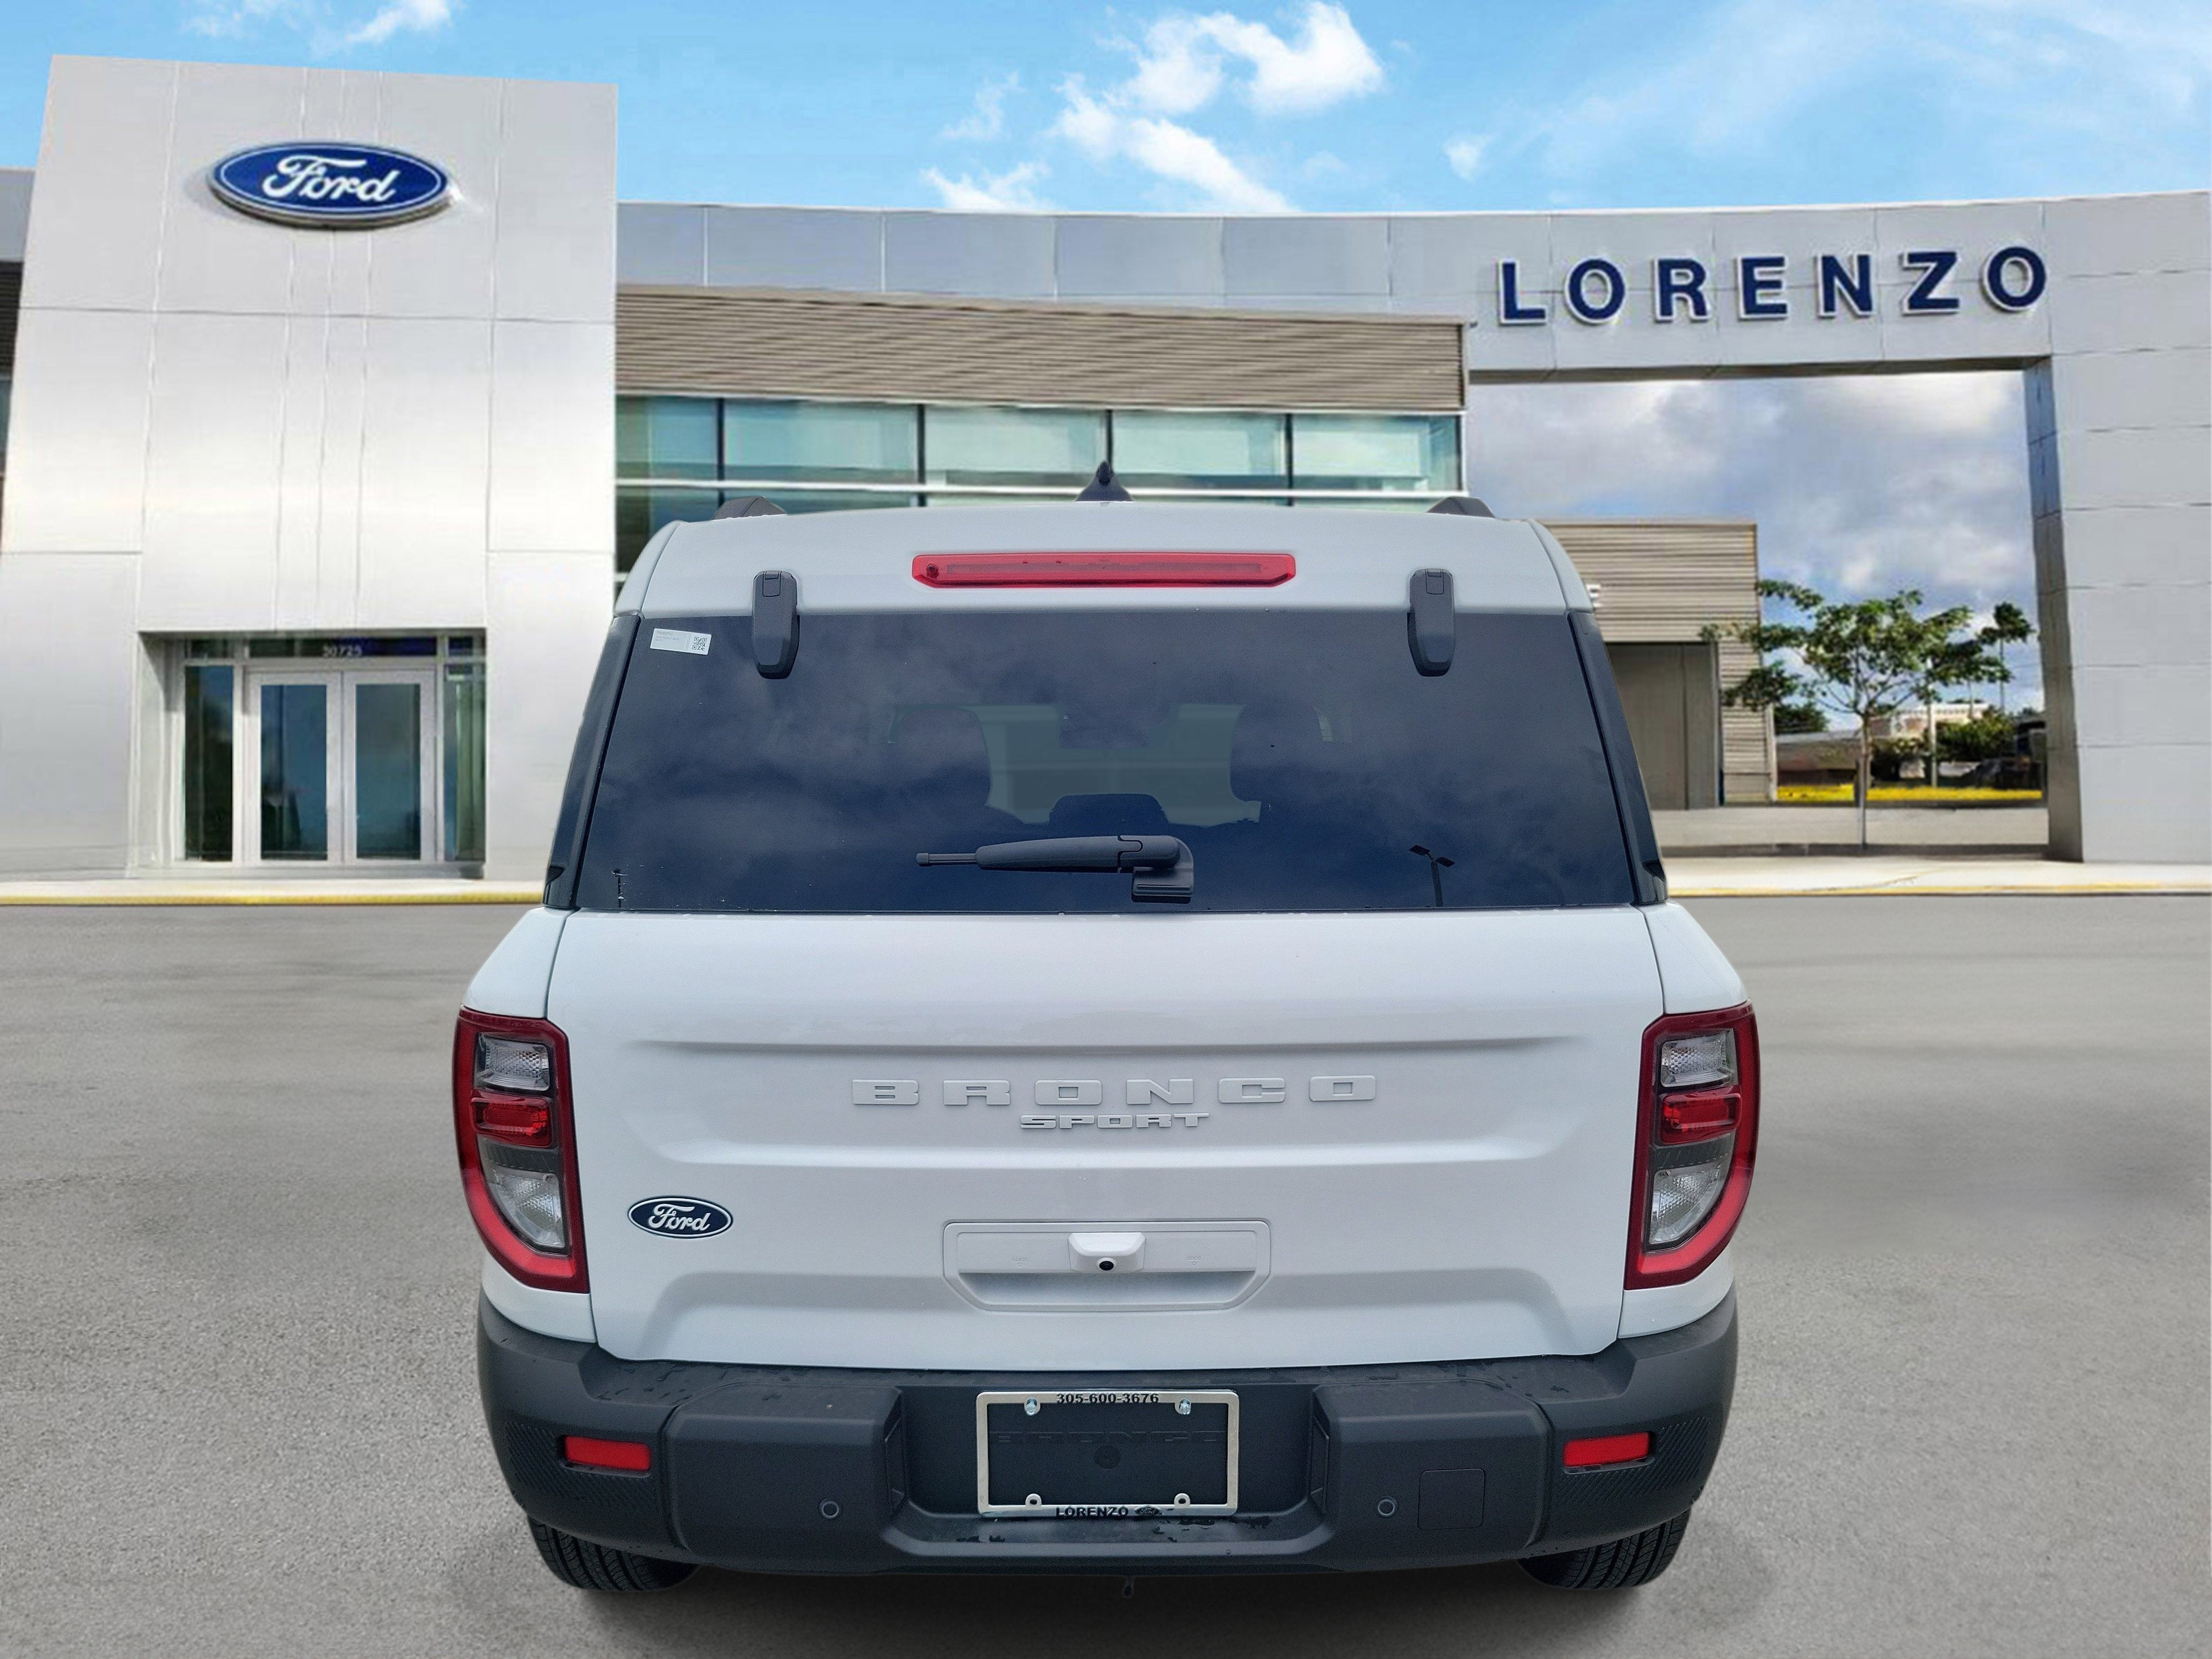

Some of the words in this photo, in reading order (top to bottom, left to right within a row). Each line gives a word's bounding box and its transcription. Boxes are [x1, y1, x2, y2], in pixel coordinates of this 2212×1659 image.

[261, 155, 401, 202] Ford
[1498, 246, 2047, 325] LORENZO
[853, 1075, 1376, 1106] BRONCO
[1020, 1113, 1210, 1129] SPORT
[648, 1203, 712, 1231] Ford
[1056, 1393, 1159, 1404] 305-600-3676
[1056, 1506, 1129, 1517] LORENZO
